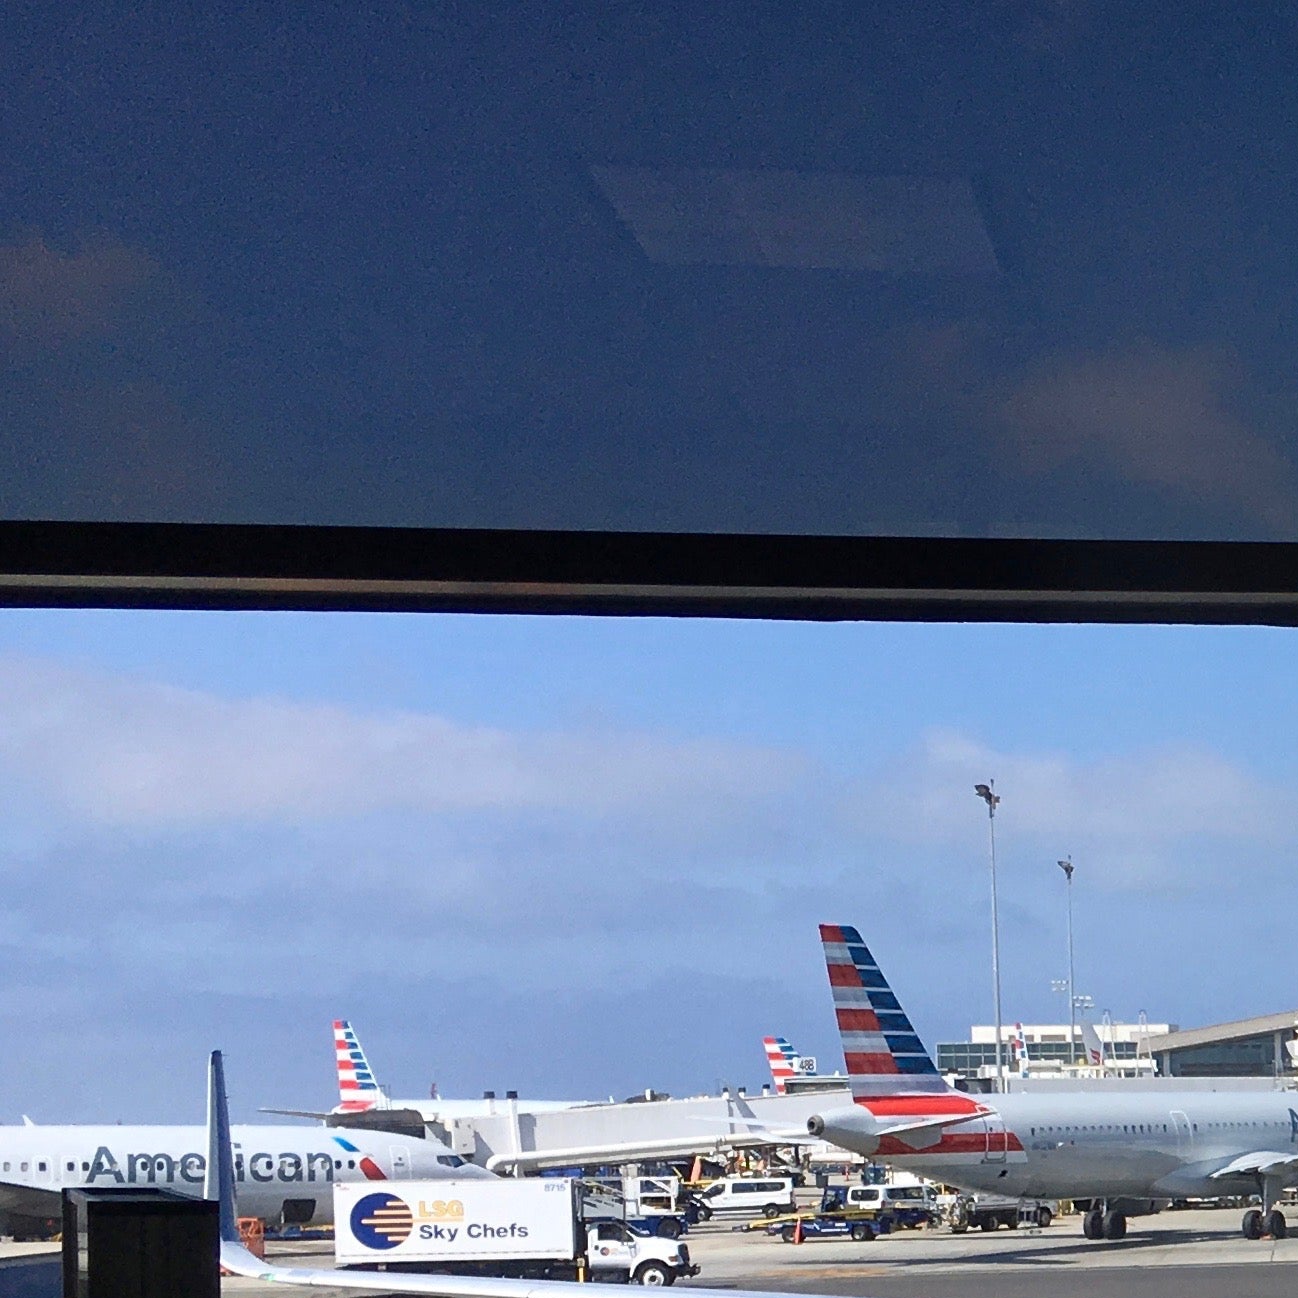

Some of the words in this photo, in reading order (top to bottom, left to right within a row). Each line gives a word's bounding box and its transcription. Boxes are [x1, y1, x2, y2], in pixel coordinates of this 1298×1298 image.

[85, 1142, 307, 1184] Ameican
[418, 1199, 464, 1217] LSG
[419, 1224, 459, 1242] Sky
[466, 1223, 529, 1239] Chefs
